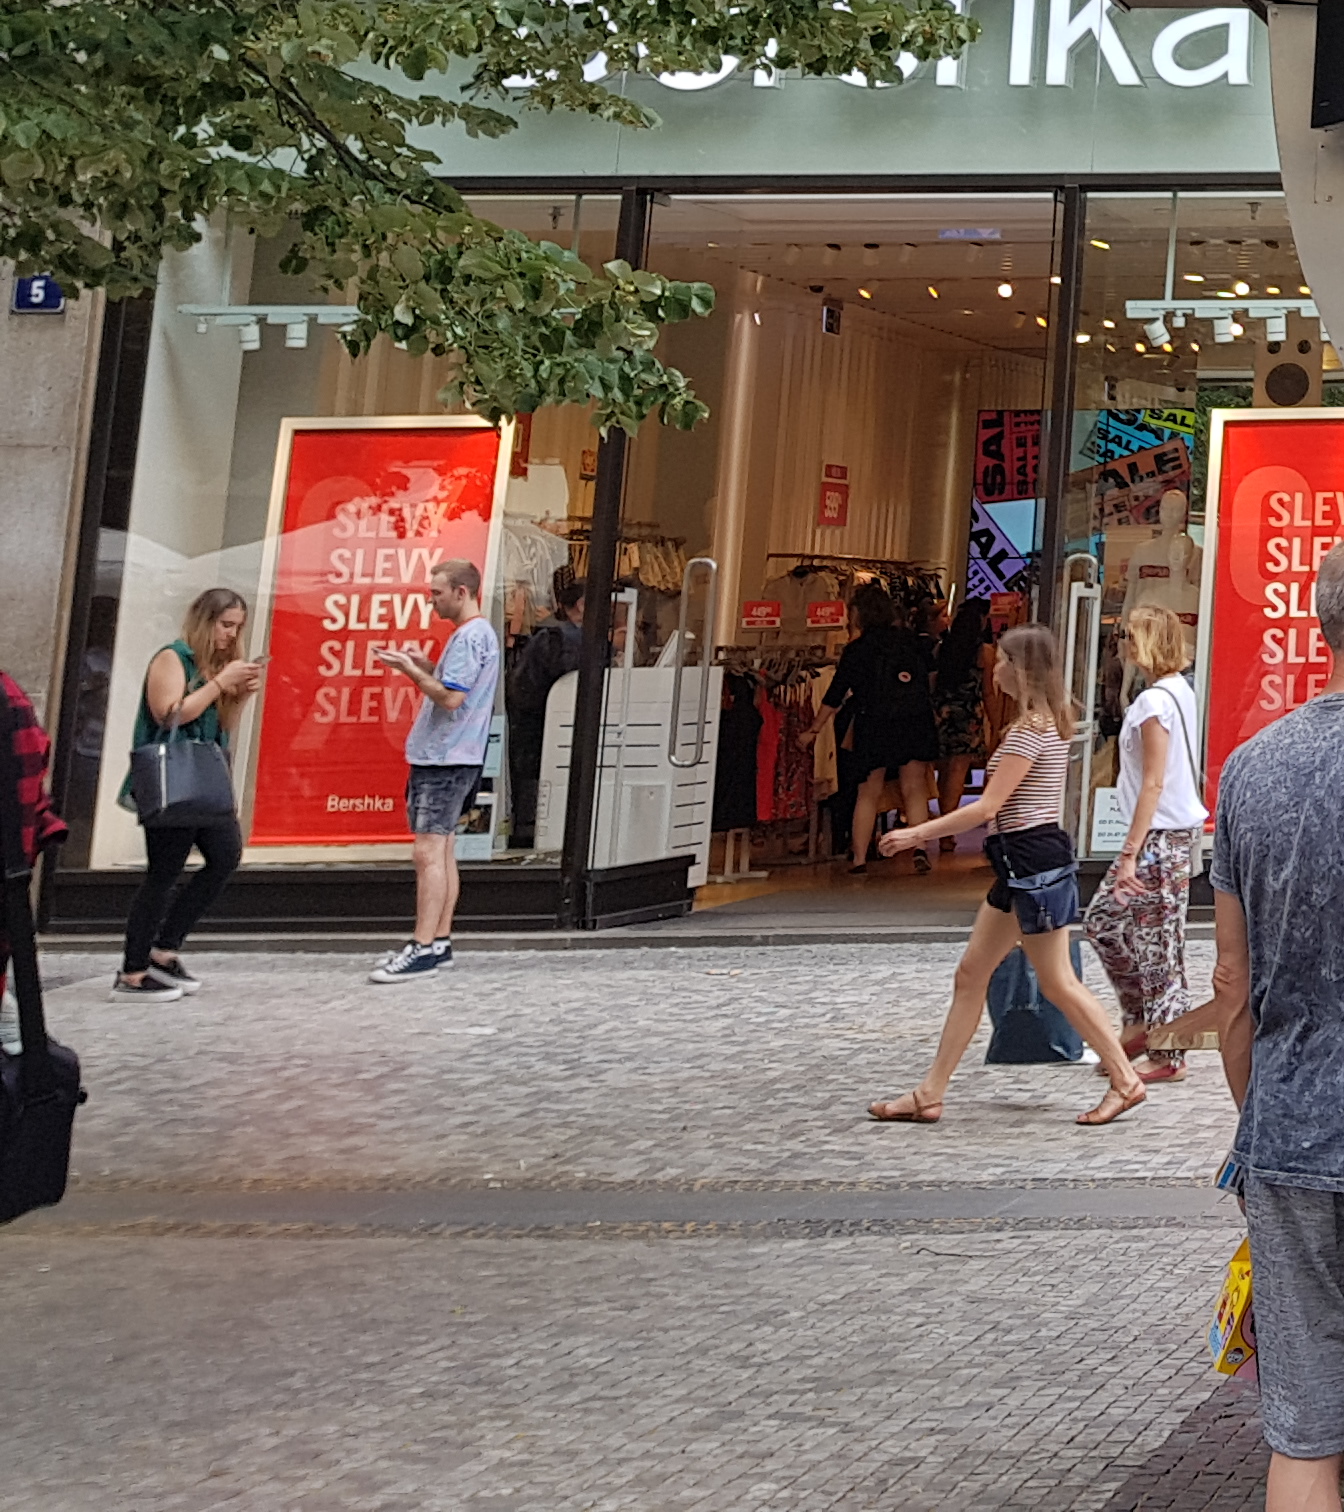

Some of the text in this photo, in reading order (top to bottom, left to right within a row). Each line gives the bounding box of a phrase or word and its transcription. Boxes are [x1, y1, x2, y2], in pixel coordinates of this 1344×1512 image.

[31, 280, 46, 304] 5
[1148, 409, 1192, 428] SAL
[981, 410, 1006, 497] SAL
[332, 501, 449, 539] SLEVY
[327, 547, 444, 585] SLEVY
[322, 593, 435, 631] SLEVY
[1260, 627, 1328, 665] SLE
[1259, 673, 1331, 712] SLE
[326, 793, 395, 813] Bershka
